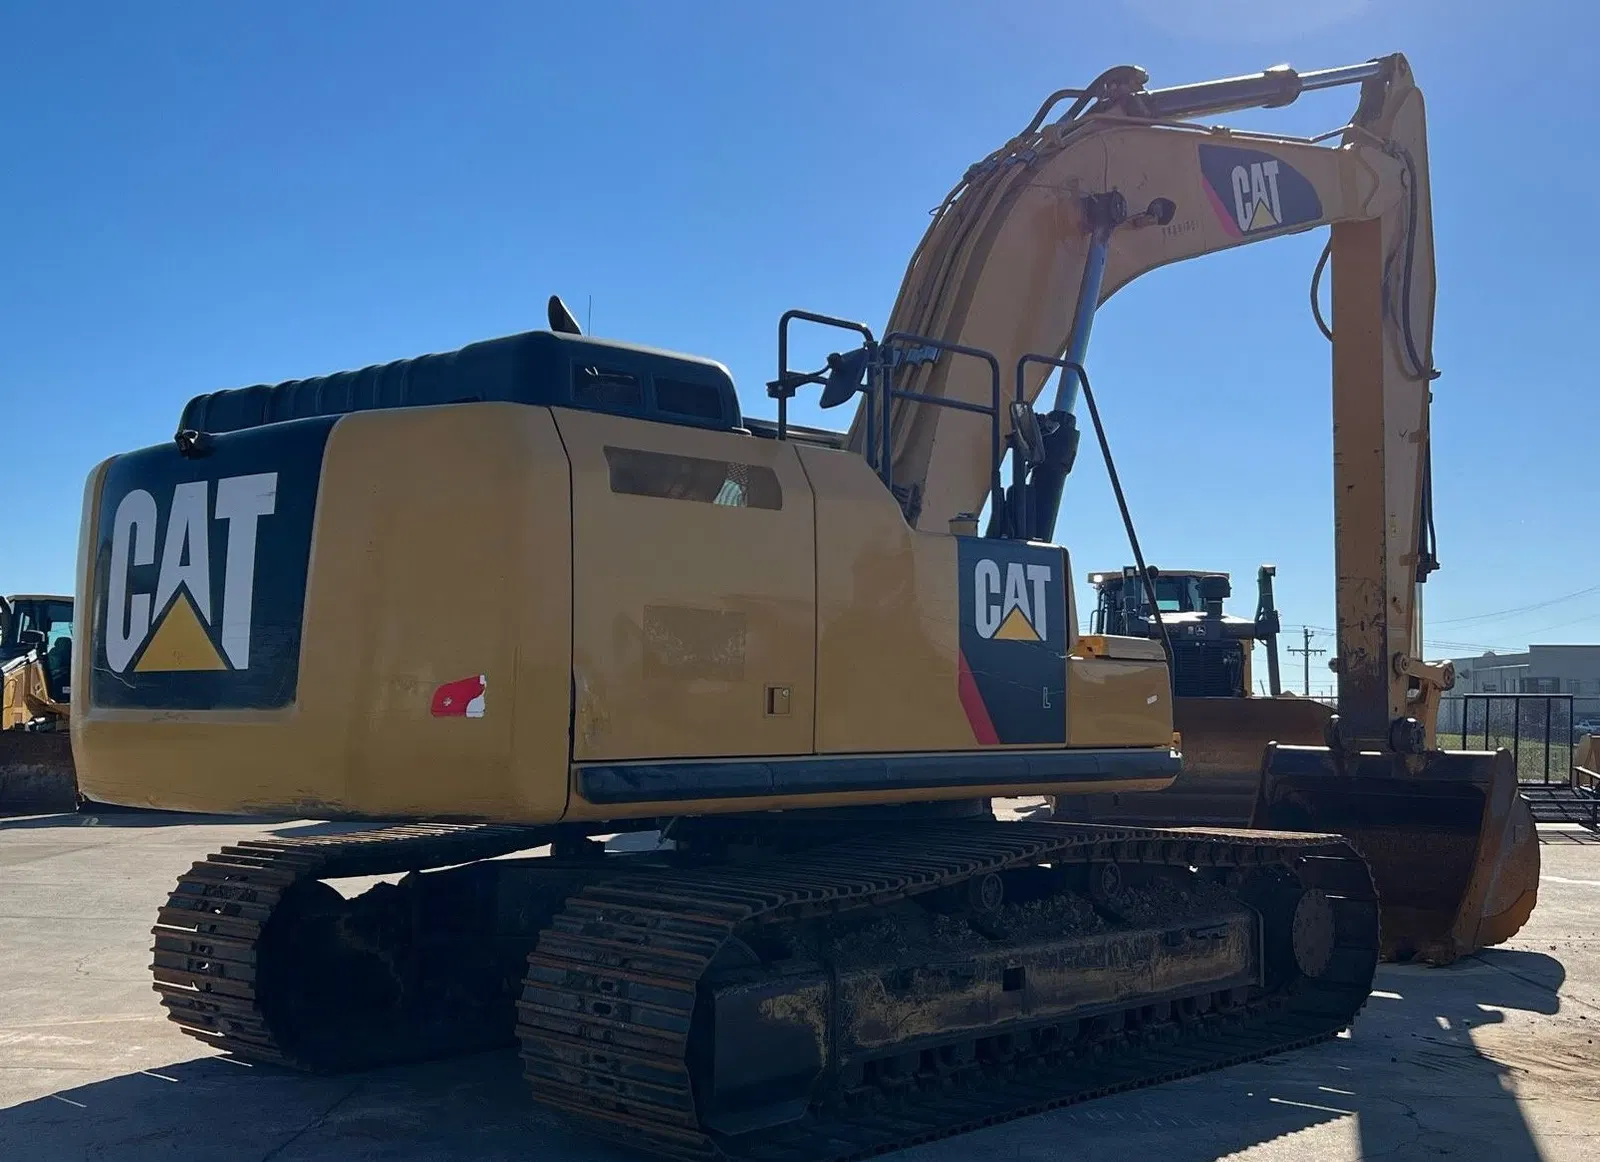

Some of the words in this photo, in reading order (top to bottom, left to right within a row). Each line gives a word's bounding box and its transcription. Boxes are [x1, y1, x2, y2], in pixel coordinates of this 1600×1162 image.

[1230, 159, 1282, 232] CAT
[105, 472, 278, 673] CAT
[974, 558, 1052, 641] CAT
